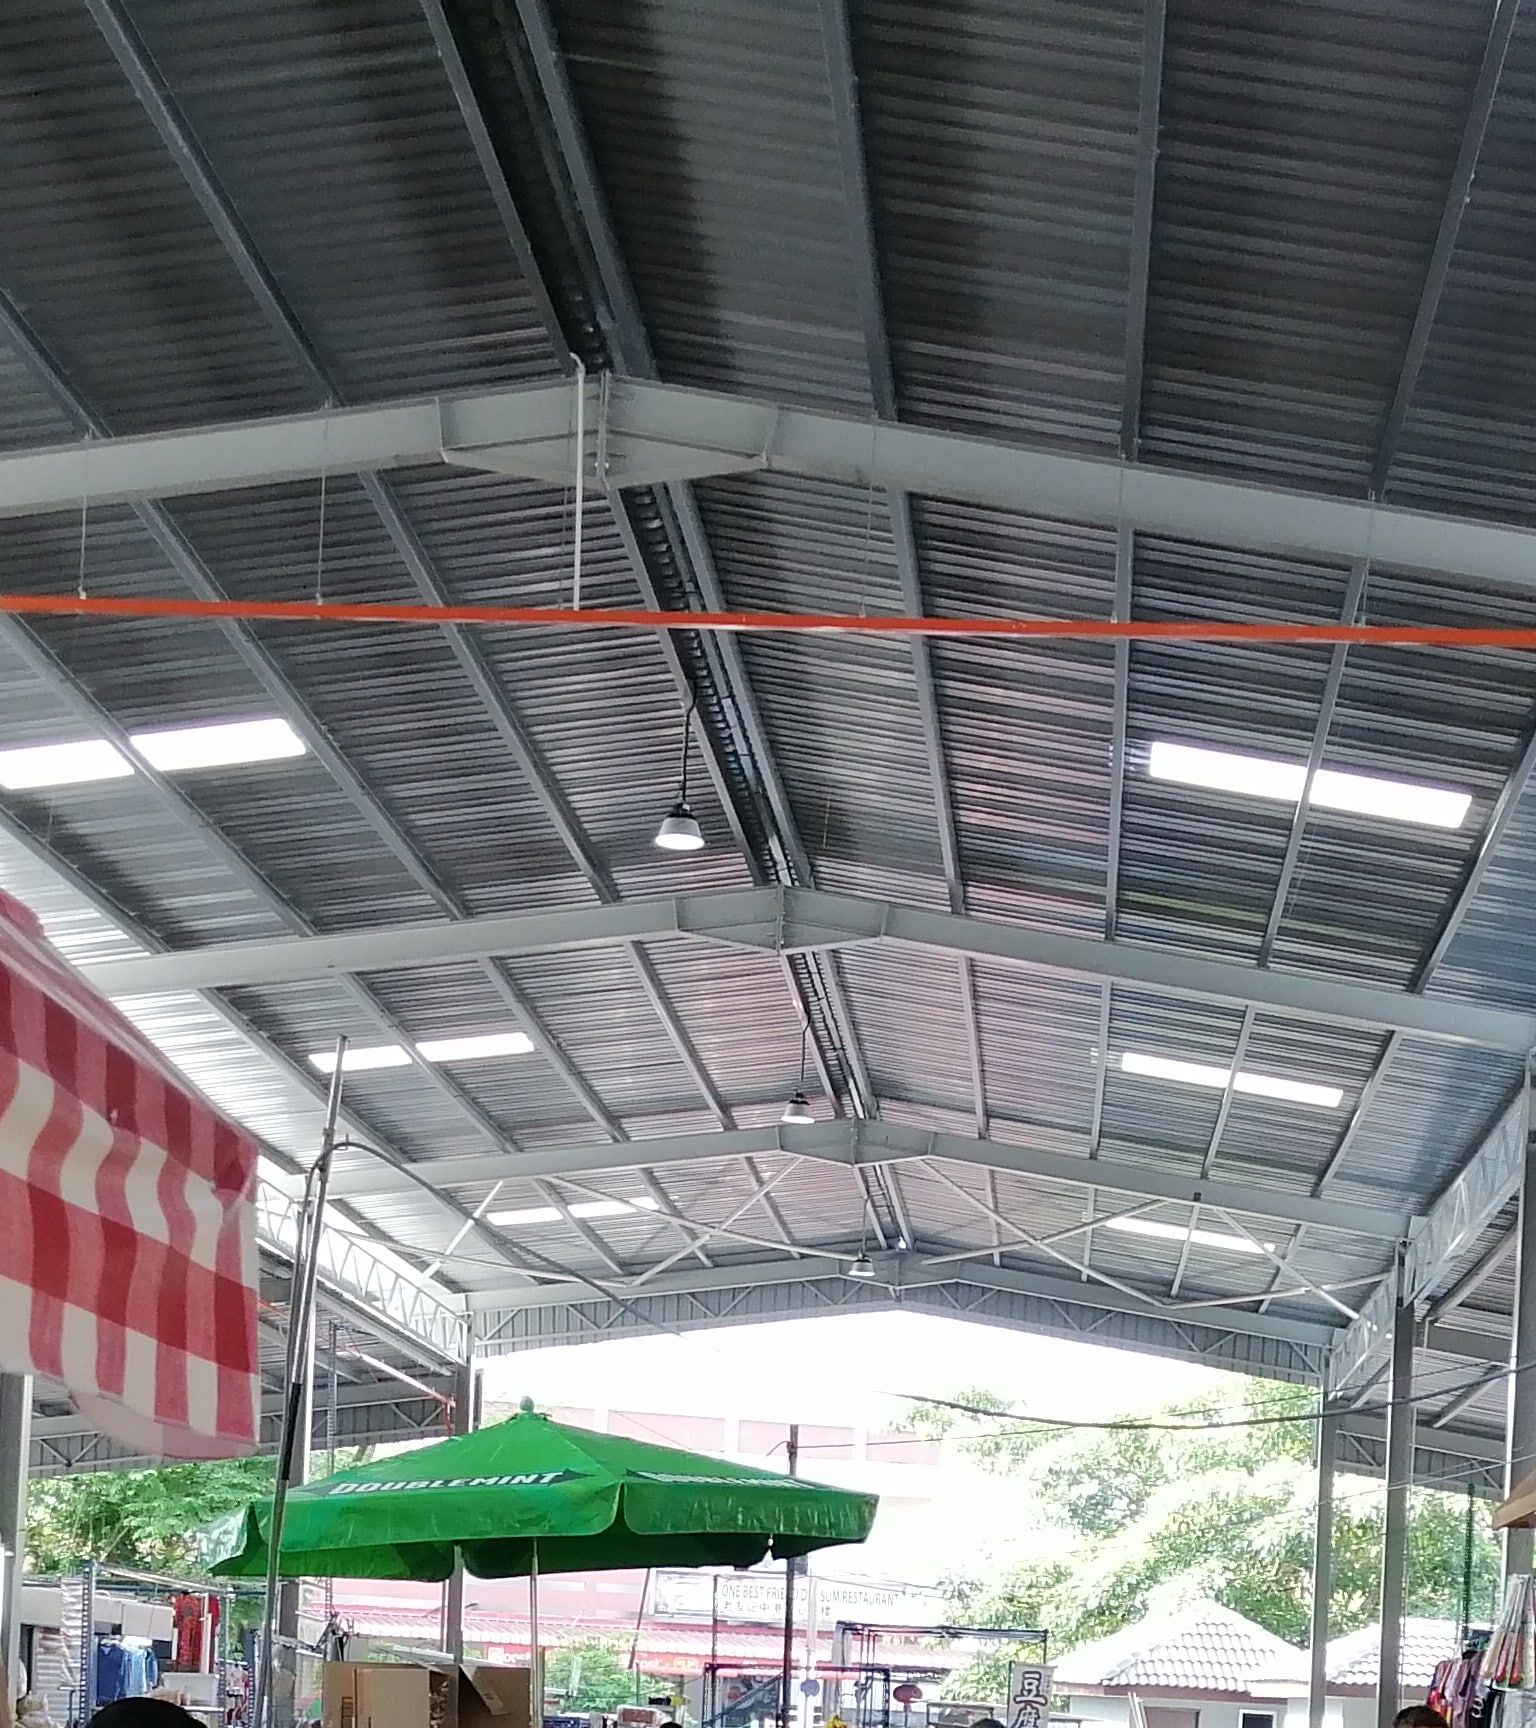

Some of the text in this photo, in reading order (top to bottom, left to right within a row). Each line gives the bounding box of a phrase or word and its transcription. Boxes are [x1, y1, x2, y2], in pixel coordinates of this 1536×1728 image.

[328, 1471, 564, 1495] DOUBLEMINT
[721, 1584, 740, 1599] ONE
[742, 1585, 764, 1600] BEST
[766, 1586, 799, 1601] FRIED
[820, 1589, 840, 1603] SUM
[842, 1590, 900, 1606] RESTAURANT
